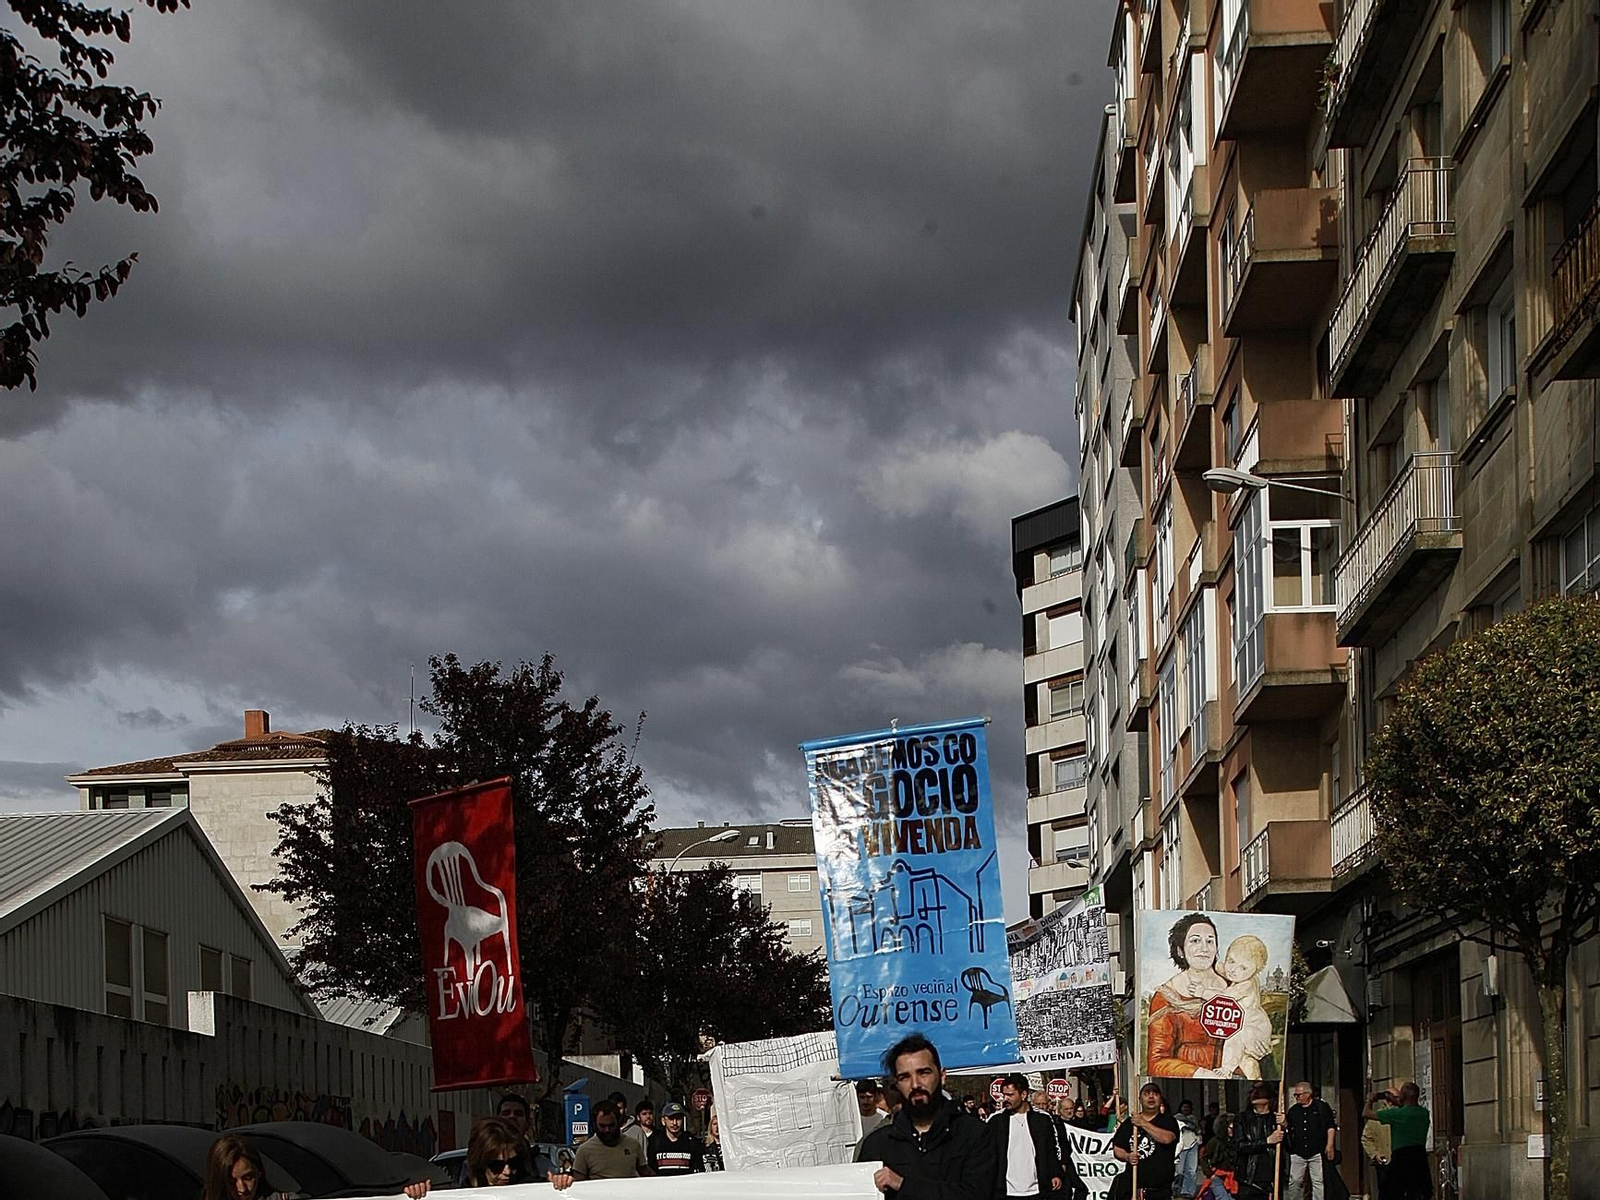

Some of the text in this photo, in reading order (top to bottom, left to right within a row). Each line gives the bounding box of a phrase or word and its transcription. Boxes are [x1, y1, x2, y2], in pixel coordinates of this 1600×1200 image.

[942, 732, 977, 765] CO
[862, 815, 982, 857] VIVENDA
[1040, 911, 1064, 927] DIGNA
[862, 976, 960, 1000] Espazo veciñal
[838, 993, 960, 1030] Ourense
[1205, 1005, 1241, 1023] STOP
[1029, 1050, 1082, 1064] VIVENDA
[1048, 1084, 1069, 1092] STOP
[693, 1094, 708, 1102] STO
[573, 1103, 583, 1115] P
[1076, 1162, 1119, 1178] EIRO
